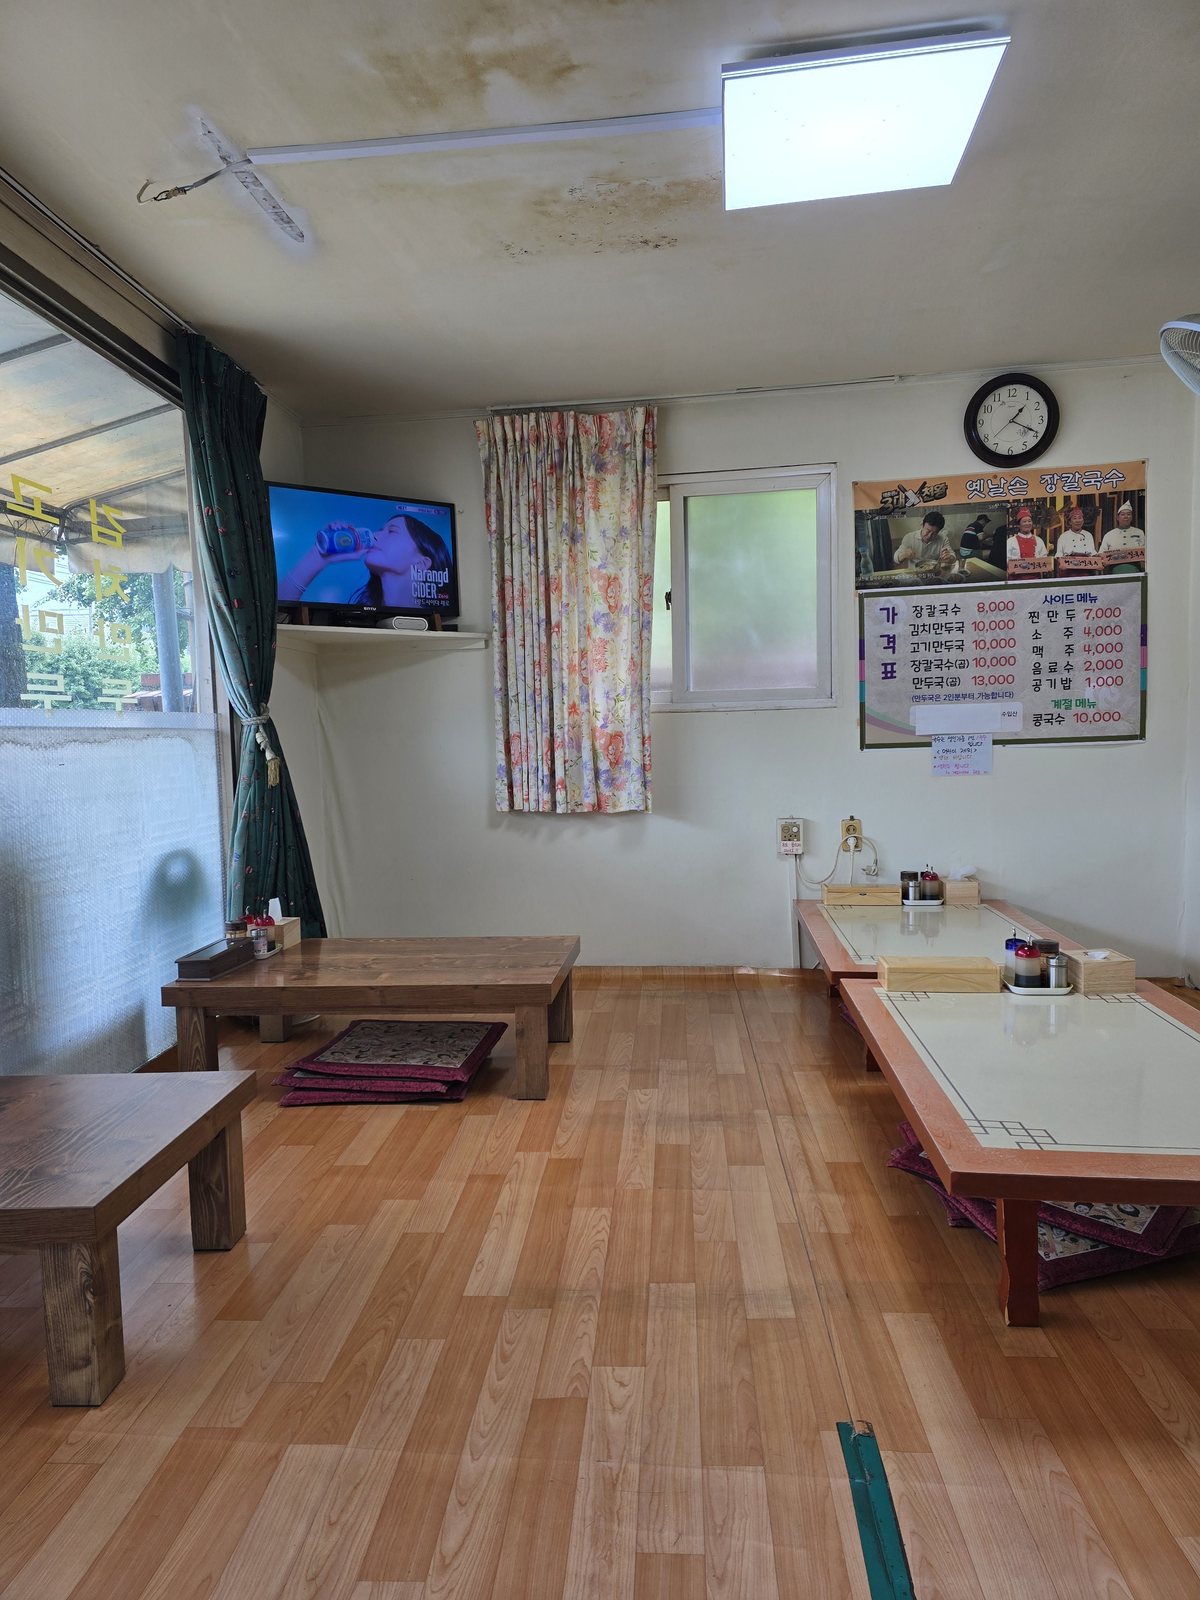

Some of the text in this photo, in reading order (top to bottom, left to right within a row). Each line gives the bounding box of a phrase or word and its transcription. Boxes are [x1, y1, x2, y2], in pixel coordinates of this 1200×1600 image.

[993, 393, 1001, 402] 11
[1007, 388, 1017, 397] 12
[1025, 392, 1029, 400] 1
[983, 405, 992, 413] 10
[1034, 402, 1040, 410] 2
[978, 419, 984, 427] 9
[1038, 416, 1044, 424] 3
[984, 434, 989, 442] 8
[993, 443, 999, 451] 7
[1007, 446, 1013, 455] 6
[1022, 441, 1027, 450] 5
[965, 468, 1125, 499] 옛날손 장칼국수
[410, 564, 449, 587] Narangd
[1042, 593, 1098, 605] 사이드 메뉴
[912, 600, 1015, 618] 장칼국수 8,000
[1083, 607, 1121, 620] 7,000
[909, 619, 1015, 637] 김치만두국 10,000
[1083, 625, 1122, 638] 4,000
[910, 637, 1016, 653] 고기만두국 10,000
[1083, 642, 1123, 656] 4,000
[972, 655, 1016, 669] 10,000
[1083, 659, 1123, 673] 2,000
[971, 674, 1015, 687] 13,000
[1085, 675, 1123, 689] 1,000
[911, 691, 1014, 703] (만두국은 2인분부터 가능합니다)
[1051, 698, 1097, 710] 계절 메뉴
[1032, 711, 1121, 727] 콩국수 10,000
